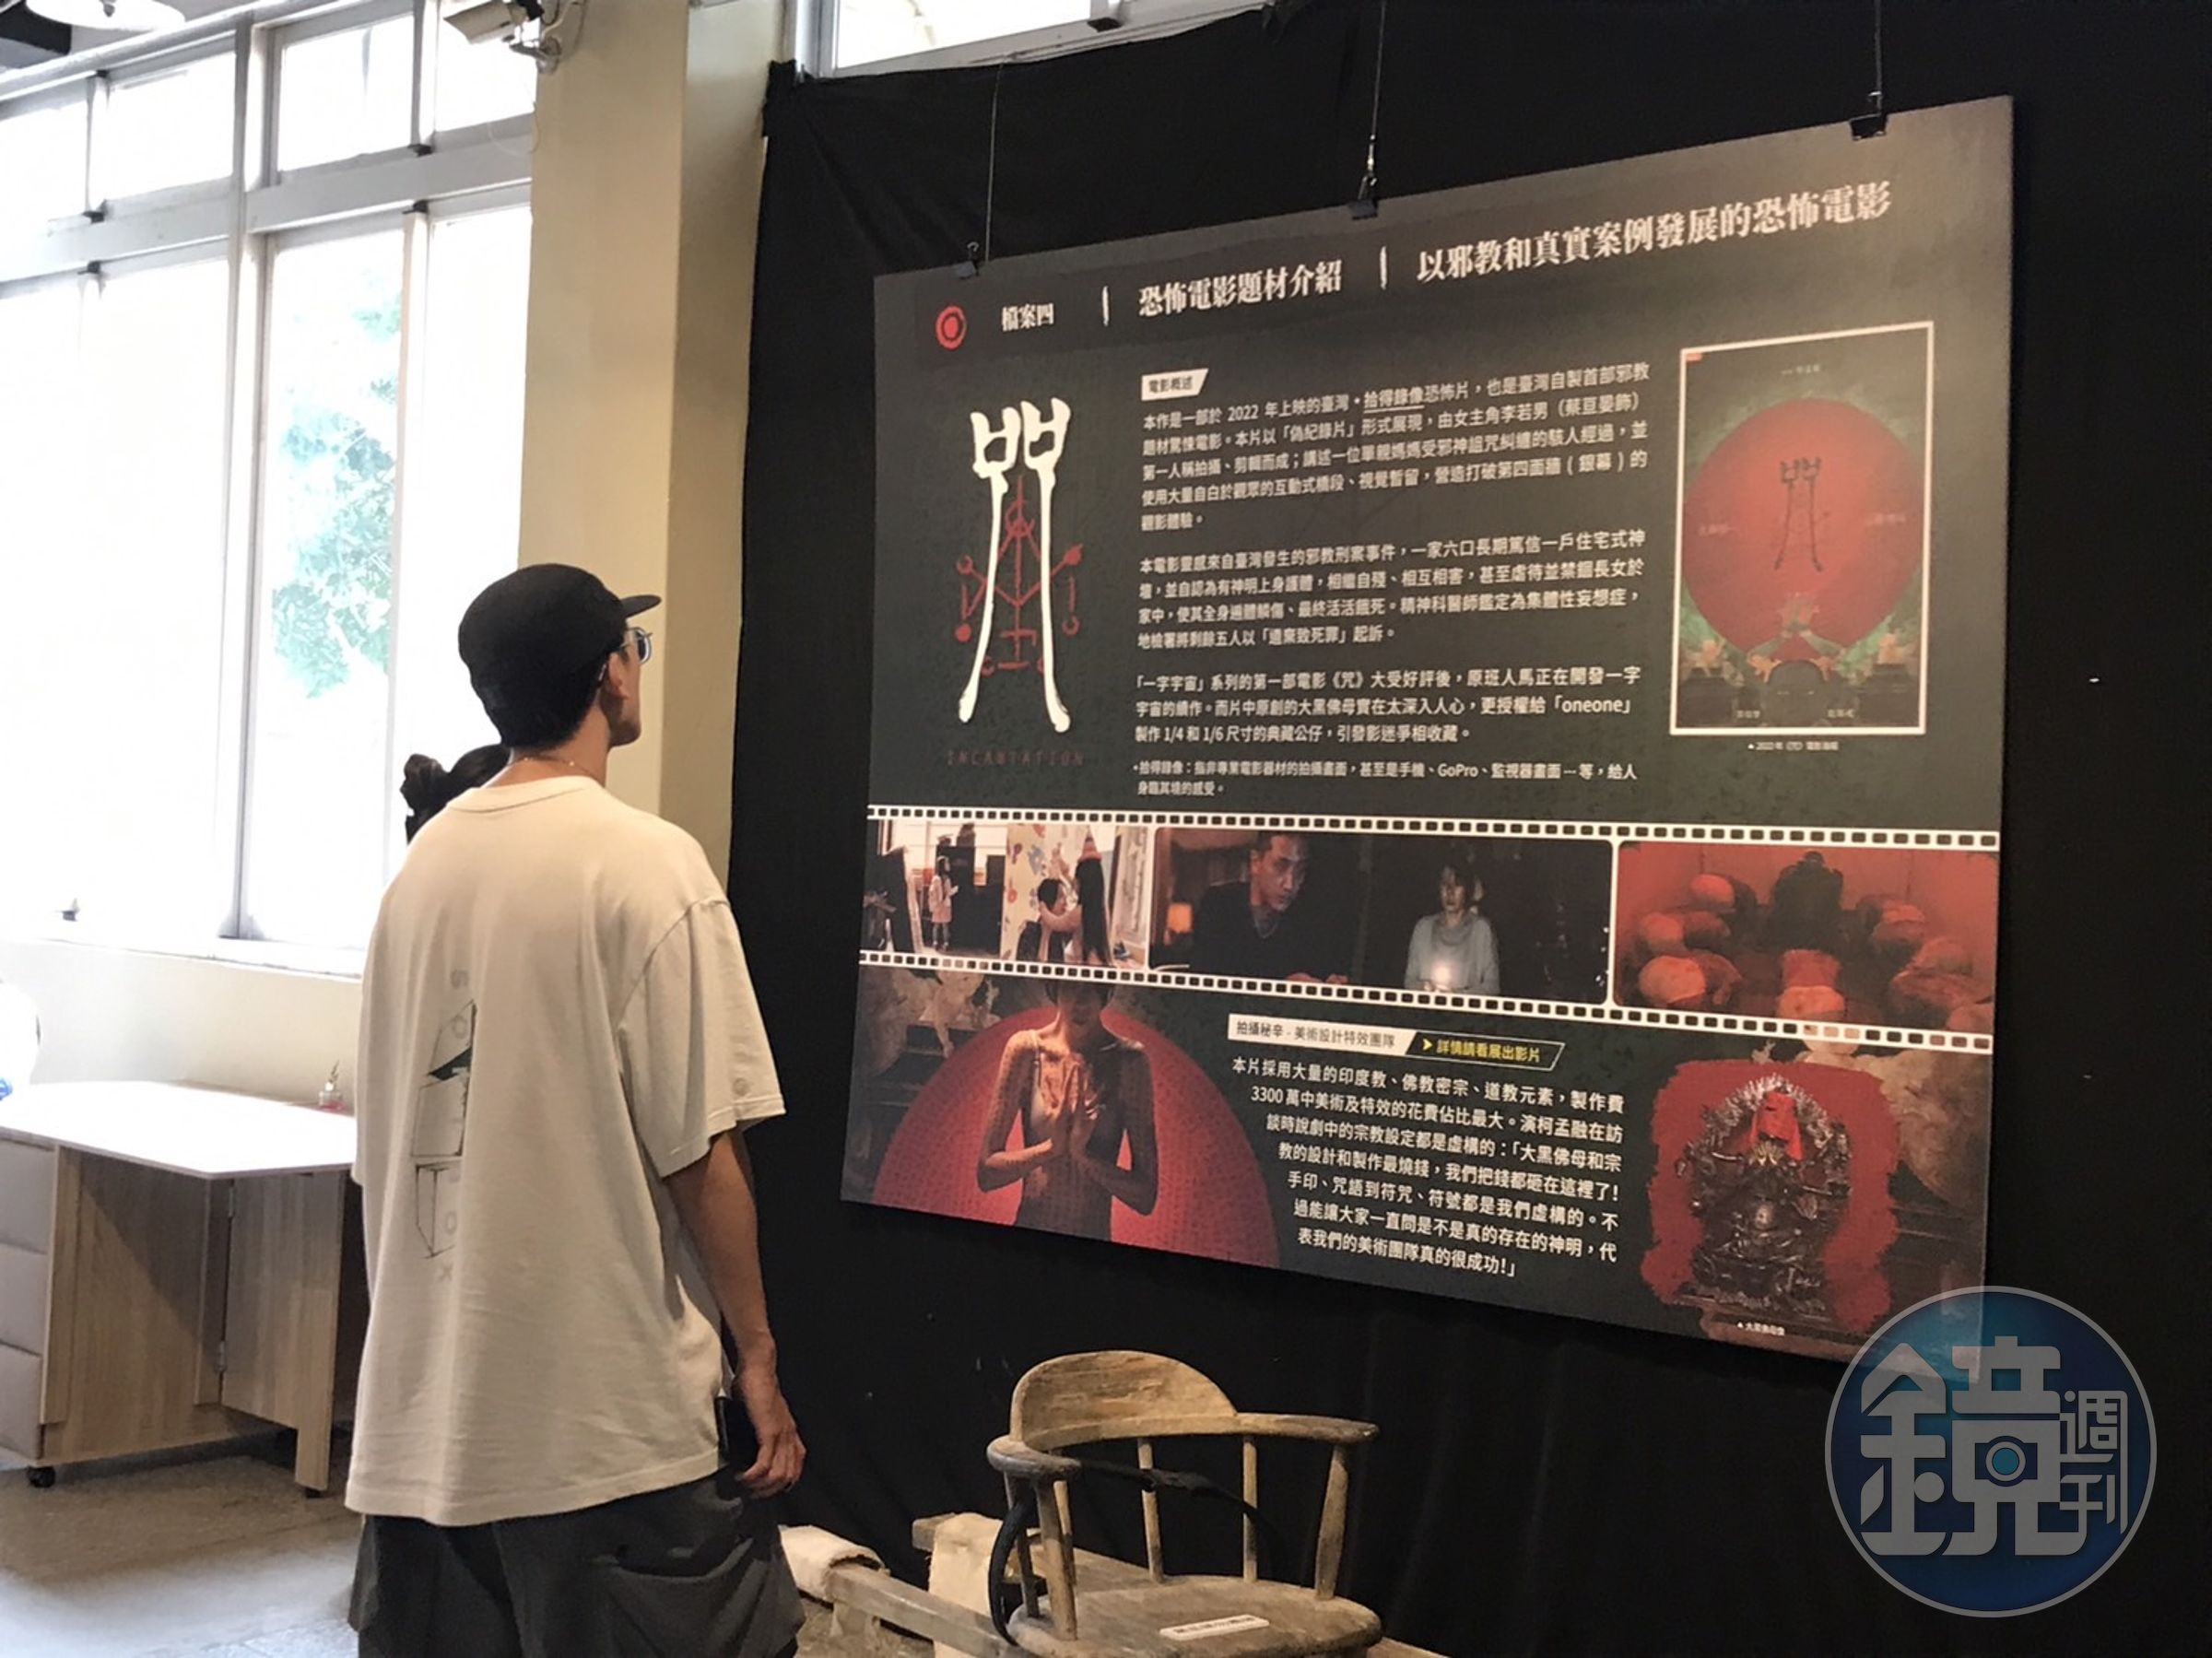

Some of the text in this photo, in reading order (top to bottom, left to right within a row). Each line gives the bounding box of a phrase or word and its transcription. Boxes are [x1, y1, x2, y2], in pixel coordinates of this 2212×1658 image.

[1001, 180, 1892, 332] 檔案四 恐怖電影題材介紹 以邪教和真實案例發展的恐怖電影
[1228, 406, 1258, 422] 2022
[1164, 726, 1183, 743] 1/4
[1186, 726, 1200, 742] 和
[1204, 726, 1223, 744] 1/6
